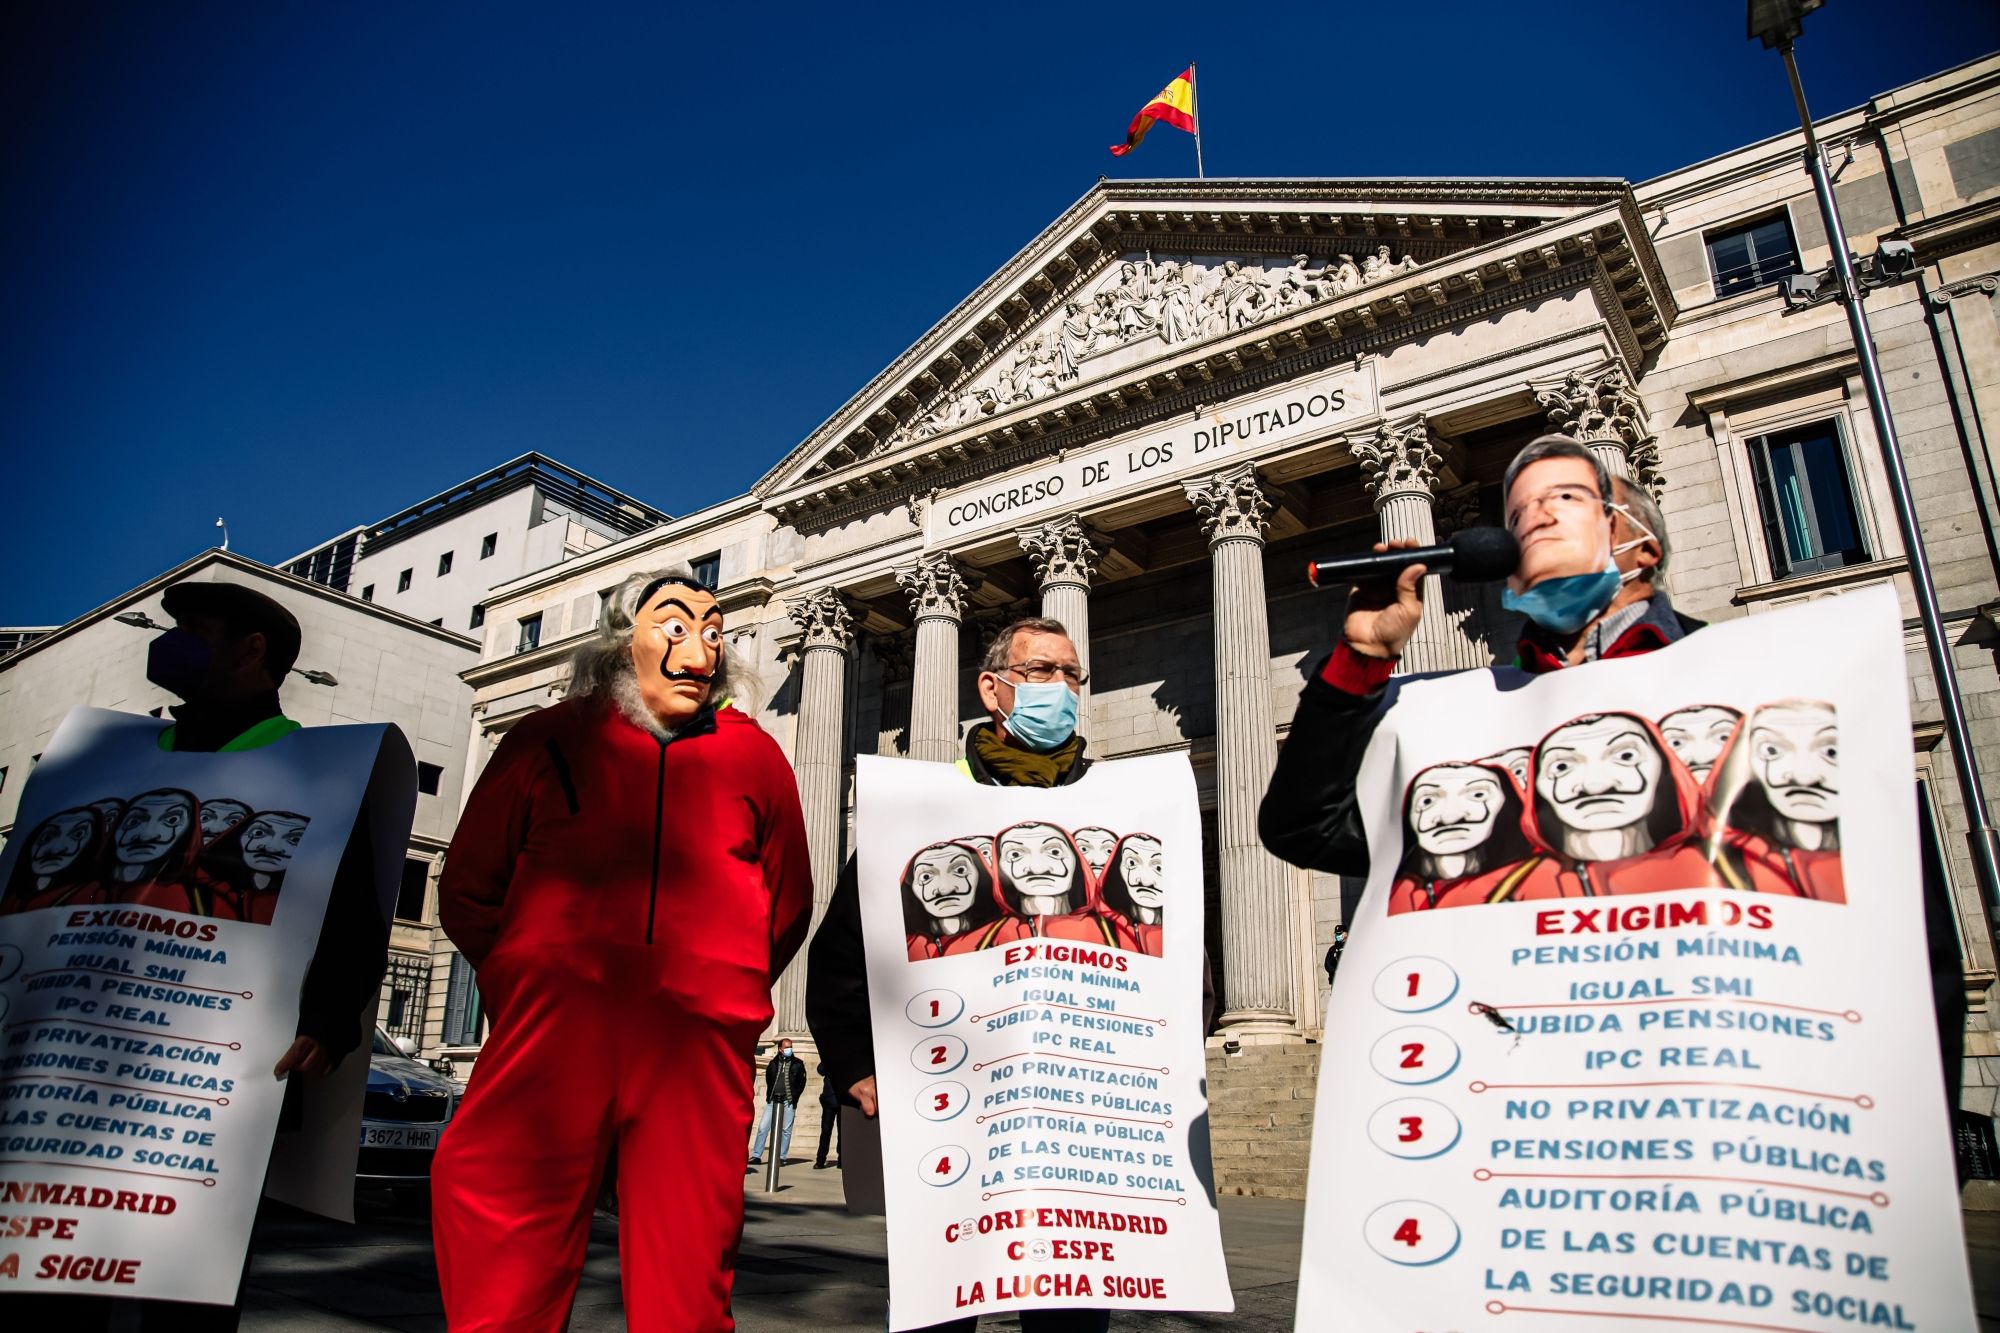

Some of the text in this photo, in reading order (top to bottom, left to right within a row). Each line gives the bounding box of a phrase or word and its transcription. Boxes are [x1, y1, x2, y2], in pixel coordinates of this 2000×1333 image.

[948, 390, 1346, 527] CONGRESO DE LOS DIPUTADOS
[66, 910, 218, 942] EXIGIMOS
[1536, 900, 1773, 936] EXIGIMOS
[48, 928, 227, 965] PENSIÓN MÍNIMA
[1005, 944, 1128, 972] EXIGIMOS
[1512, 932, 1802, 966] PENSIÓN MÍNIMA
[66, 954, 186, 983] IGUAL SMI
[993, 964, 1142, 993] PENSIÓN MÍNIMA
[26, 974, 232, 1011] SUBIDA PENSIONES
[1406, 974, 1420, 996] 1
[1569, 977, 1752, 1001] IGUAL SMI
[56, 998, 171, 1027] IPC REAL
[930, 1000, 939, 1017] 1
[1023, 990, 1116, 1012] IGUAL SMI
[986, 1009, 1154, 1038] SUBIDA PENSIONES
[1639, 1010, 1835, 1042] PENSIONES
[35, 1028, 222, 1066] PRIVATIZACIÓN
[930, 1046, 947, 1064] 2
[1032, 1032, 1116, 1054] IPC REAL
[1399, 1044, 1424, 1068] 2
[1584, 1048, 1761, 1070] IPC REAL
[116, 1062, 235, 1093] PÚBLICAS
[990, 1062, 1158, 1090] NO PRIVATIZACIÓN
[108, 1092, 212, 1122] PÚBLICA
[934, 1093, 950, 1110] 3
[984, 1086, 1173, 1116] PENSIONES PÚBLICAS
[0, 1110, 216, 1147] LAS CUENTAS DE
[988, 1115, 1165, 1144] AUDITORÍA PÚBLICA
[1397, 1116, 1423, 1142] 3
[1505, 1099, 1851, 1136] NO PRIVATIZACIÓN
[368, 1130, 430, 1146] 3672 HHR
[0, 1137, 220, 1174] EGURIDAD SOCIAL
[935, 1156, 952, 1175] 4
[988, 1140, 1173, 1168] DE LAS CUENTAS DE
[1490, 1136, 1886, 1183] PENSIONES PÚBLICAS
[981, 1166, 1185, 1192] LA SEGURIDAD SOCIAL
[1498, 1184, 1873, 1235] AUDITORÍA PÚBLICA
[1394, 1219, 1422, 1247] 4
[1501, 1228, 1889, 1281] DE LAS CUENTAS DE
[36, 1255, 141, 1284] SIGUE
[956, 1274, 1166, 1308] LA LUCHA SIGUE
[1485, 1269, 1915, 1330] LA SEGURIDAD SOCIAL
